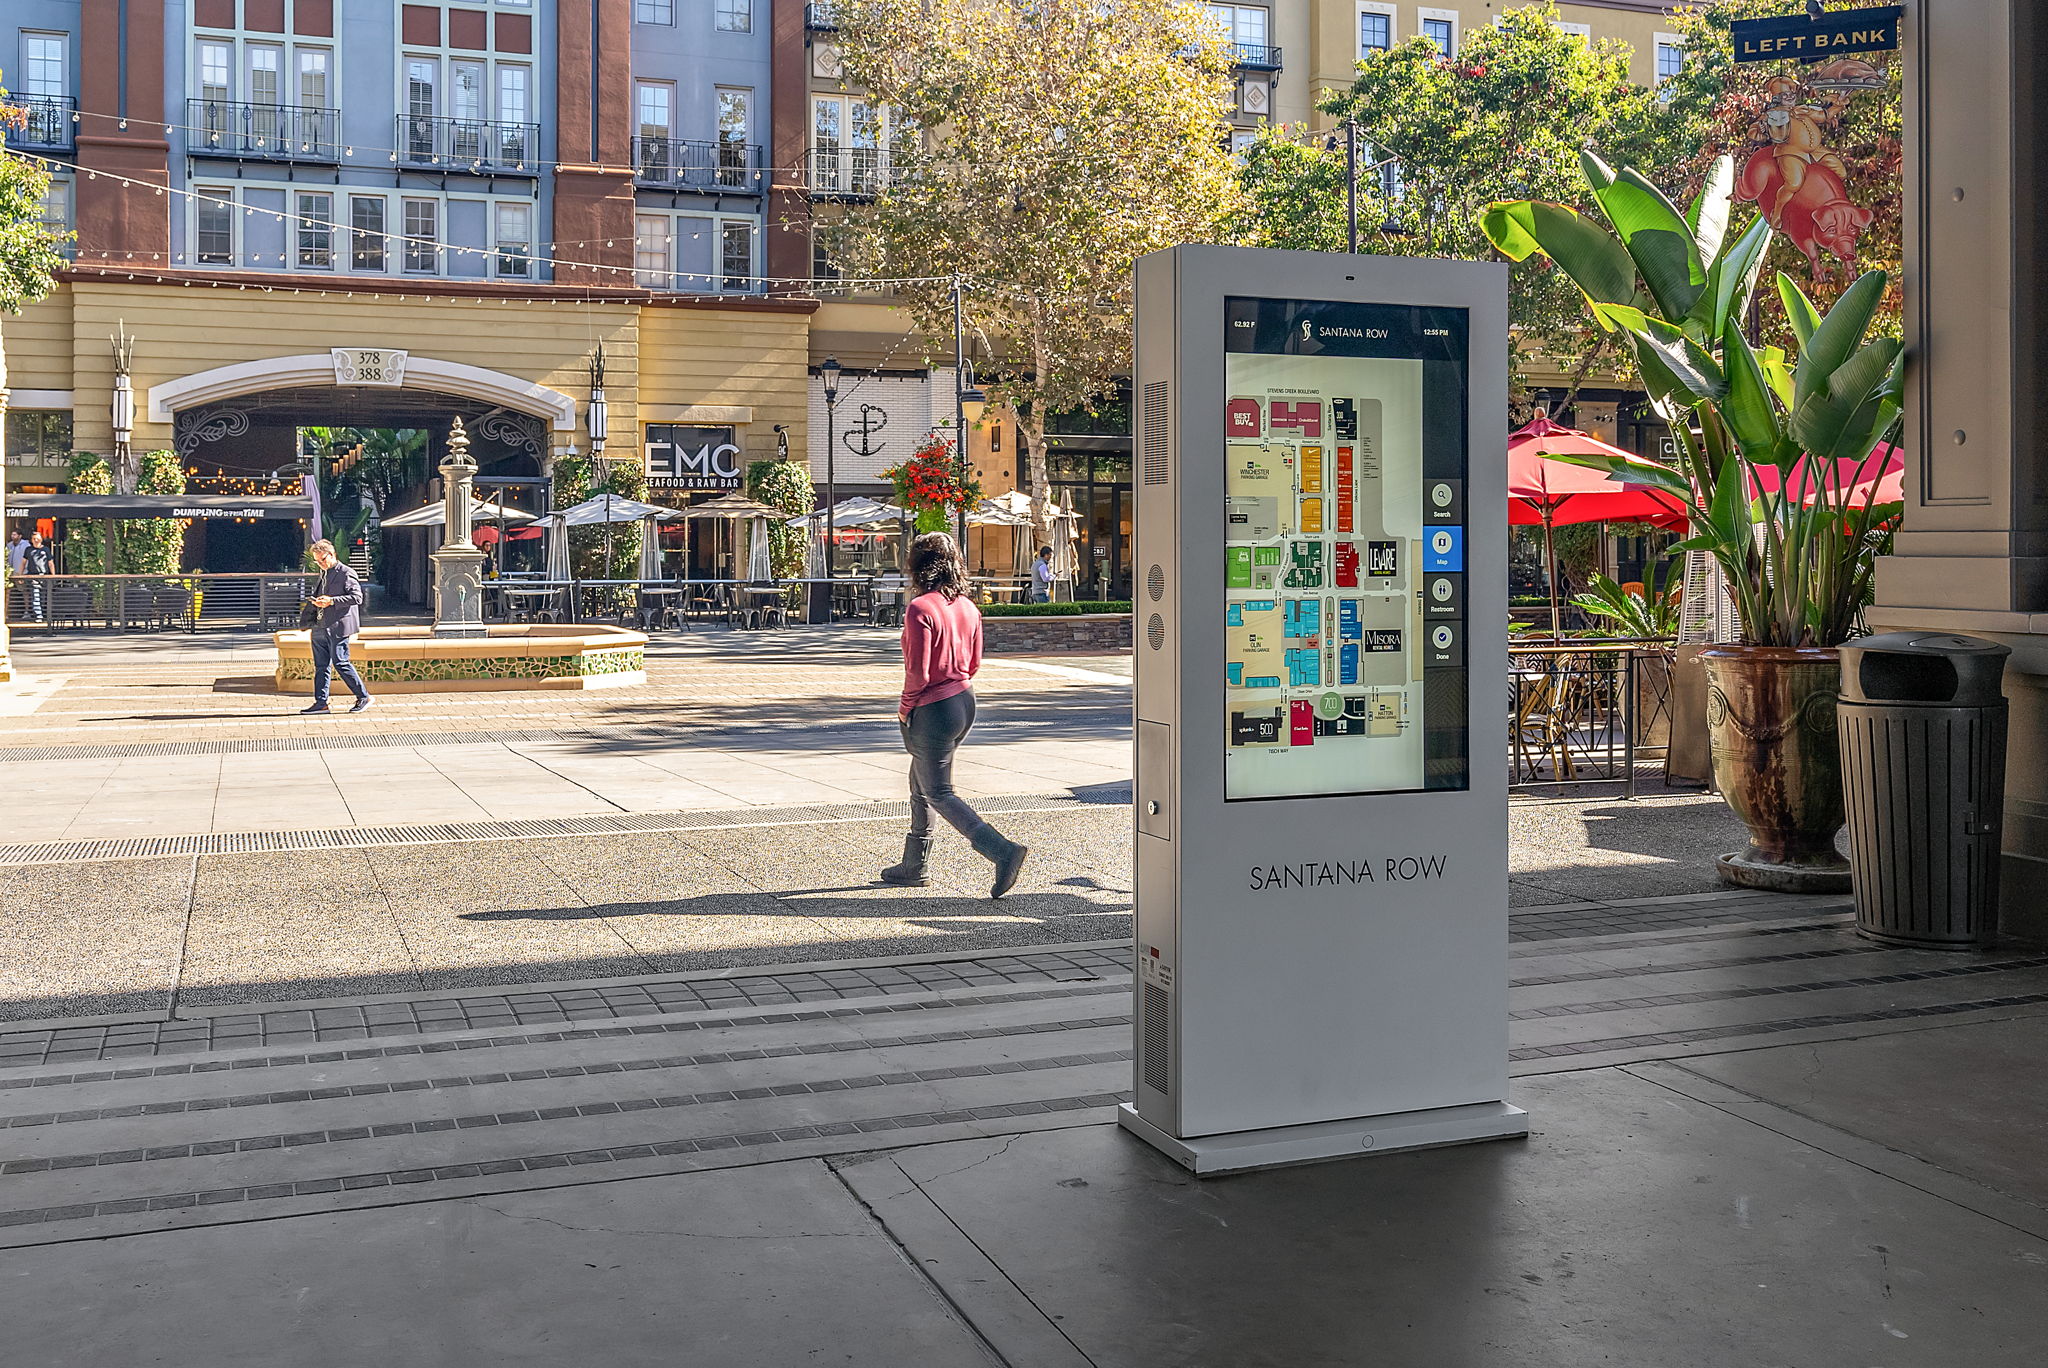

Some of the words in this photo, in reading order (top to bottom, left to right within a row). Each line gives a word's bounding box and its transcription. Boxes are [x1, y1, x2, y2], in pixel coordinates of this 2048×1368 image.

[1744, 36, 1806, 53] LEFT
[1815, 29, 1886, 48] BANK
[1320, 327, 1363, 338] SANTANA
[1366, 329, 1388, 339] ROW
[359, 352, 380, 364] 378
[359, 367, 381, 381] 388
[1233, 412, 1251, 420] BEST
[645, 443, 741, 478] EMC
[644, 478, 684, 488] SEAFOOD
[688, 479, 694, 487] &
[697, 478, 717, 488] RAW
[721, 478, 739, 488] BAR
[1370, 548, 1396, 570] LEVARE
[1366, 631, 1400, 645] MISORA
[1324, 697, 1337, 709] 700
[1259, 723, 1273, 735] 500
[1250, 859, 1374, 890] SANTANA
[1386, 855, 1447, 882] ROW
